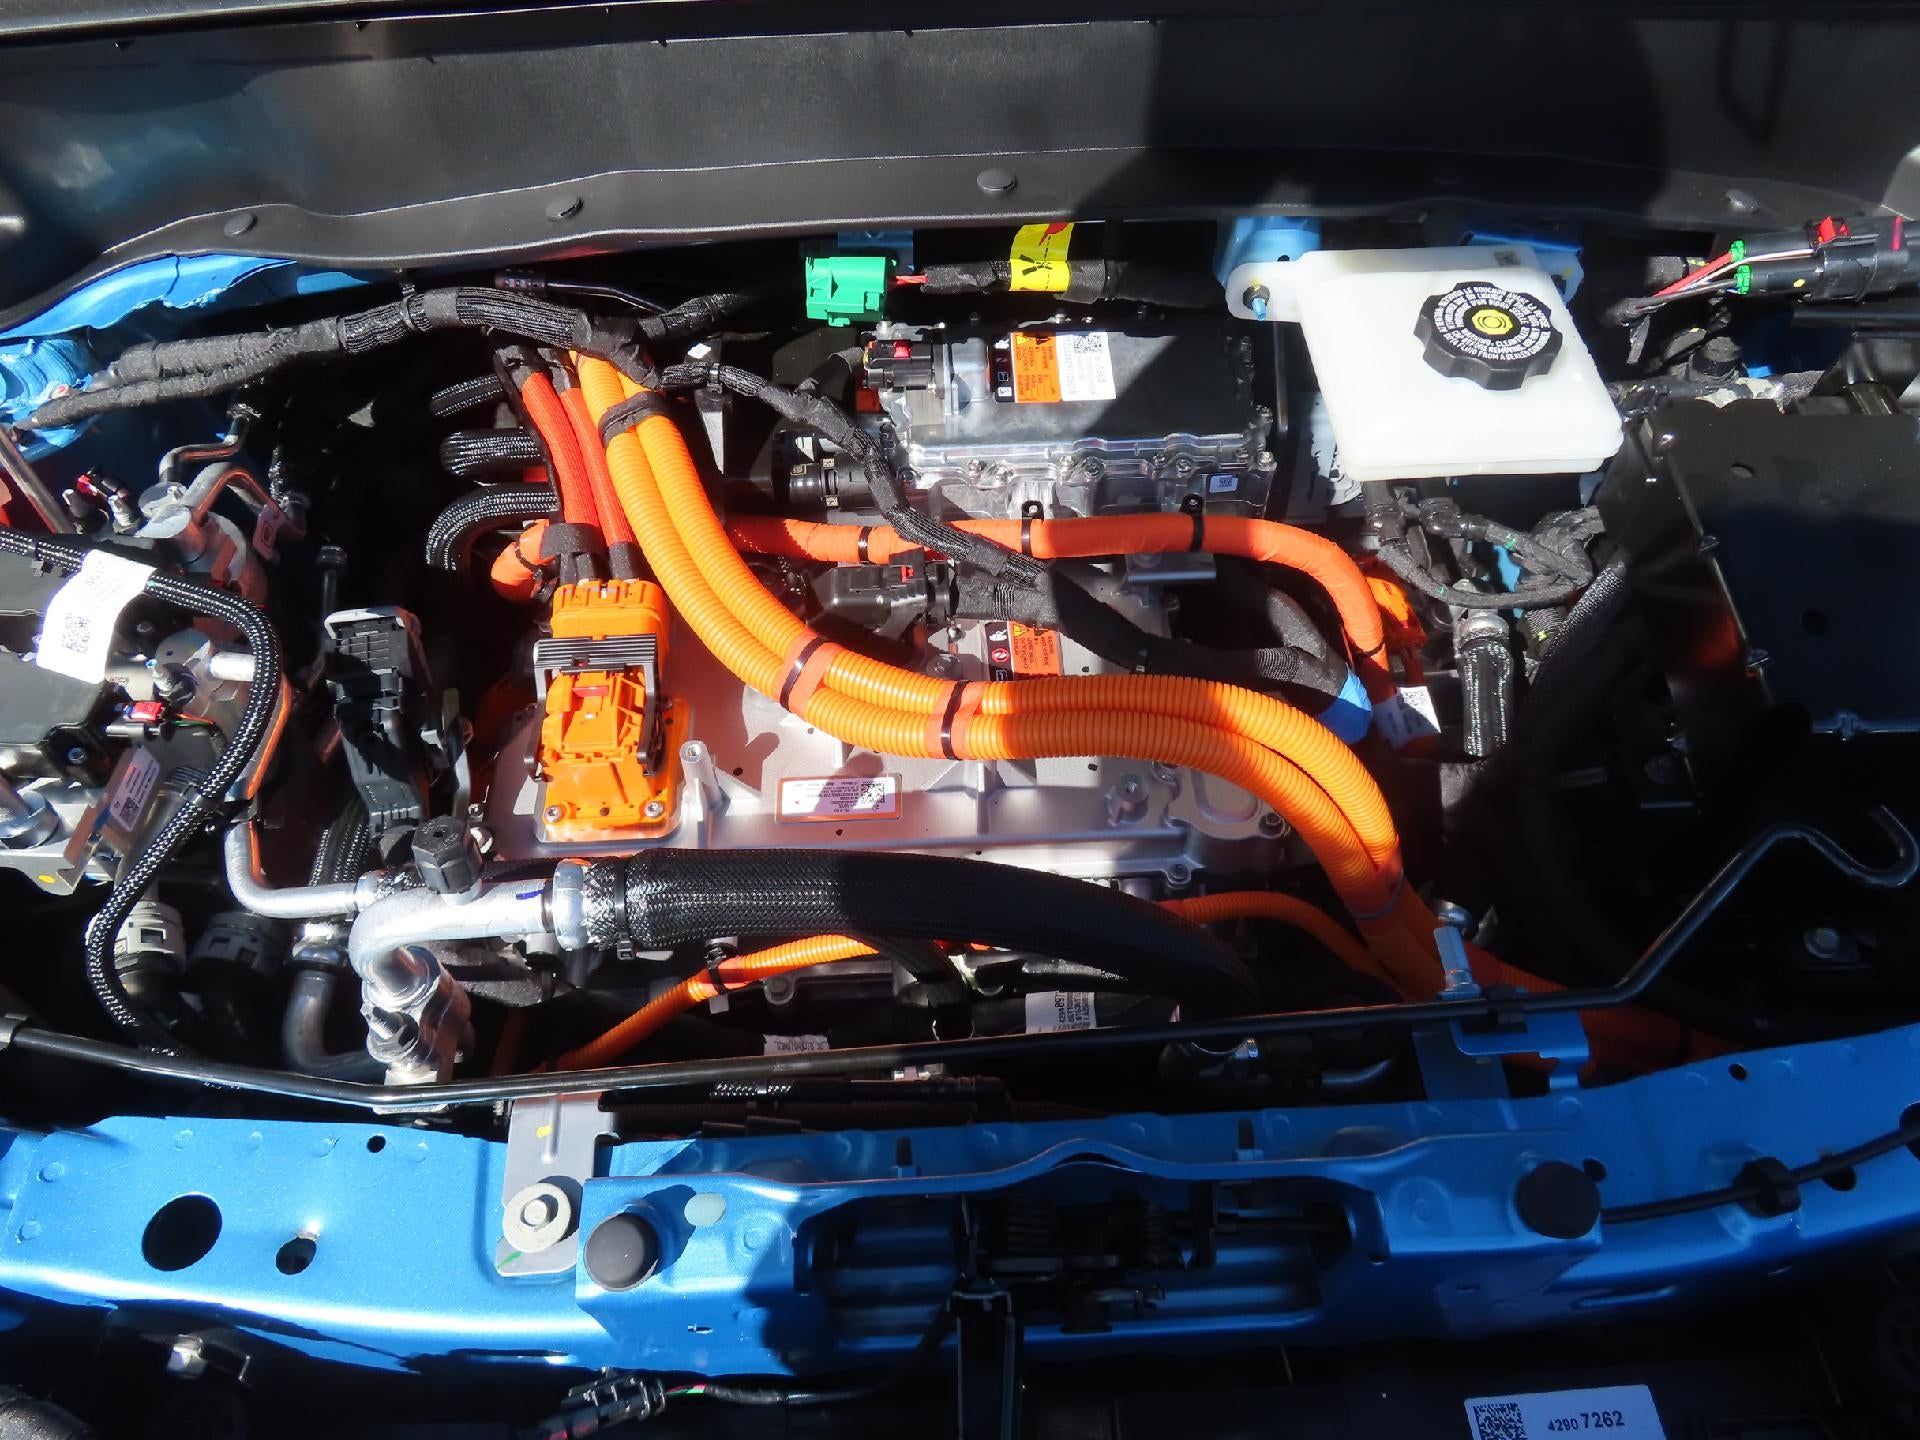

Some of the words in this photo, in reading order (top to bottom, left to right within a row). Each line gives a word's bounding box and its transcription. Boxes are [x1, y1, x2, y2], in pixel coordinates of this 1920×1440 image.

[1463, 286, 1473, 294] LE
[1473, 286, 1507, 296] BOUCHON
[1506, 292, 1529, 304] AVANT
[1527, 302, 1537, 310] LA
[1477, 293, 1503, 302] LIQUIDE
[1504, 296, 1514, 305] DE
[1488, 299, 1510, 310] BIDON
[1461, 337, 1487, 352] BEFORE
[1495, 336, 1519, 347] CLEAN
[1457, 342, 1478, 355] FLUID
[1478, 350, 1499, 360] FROM
[1505, 350, 1531, 360] SEALED
[1548, 1418, 1578, 1432] 4290
[1580, 1410, 1625, 1429] 7262
